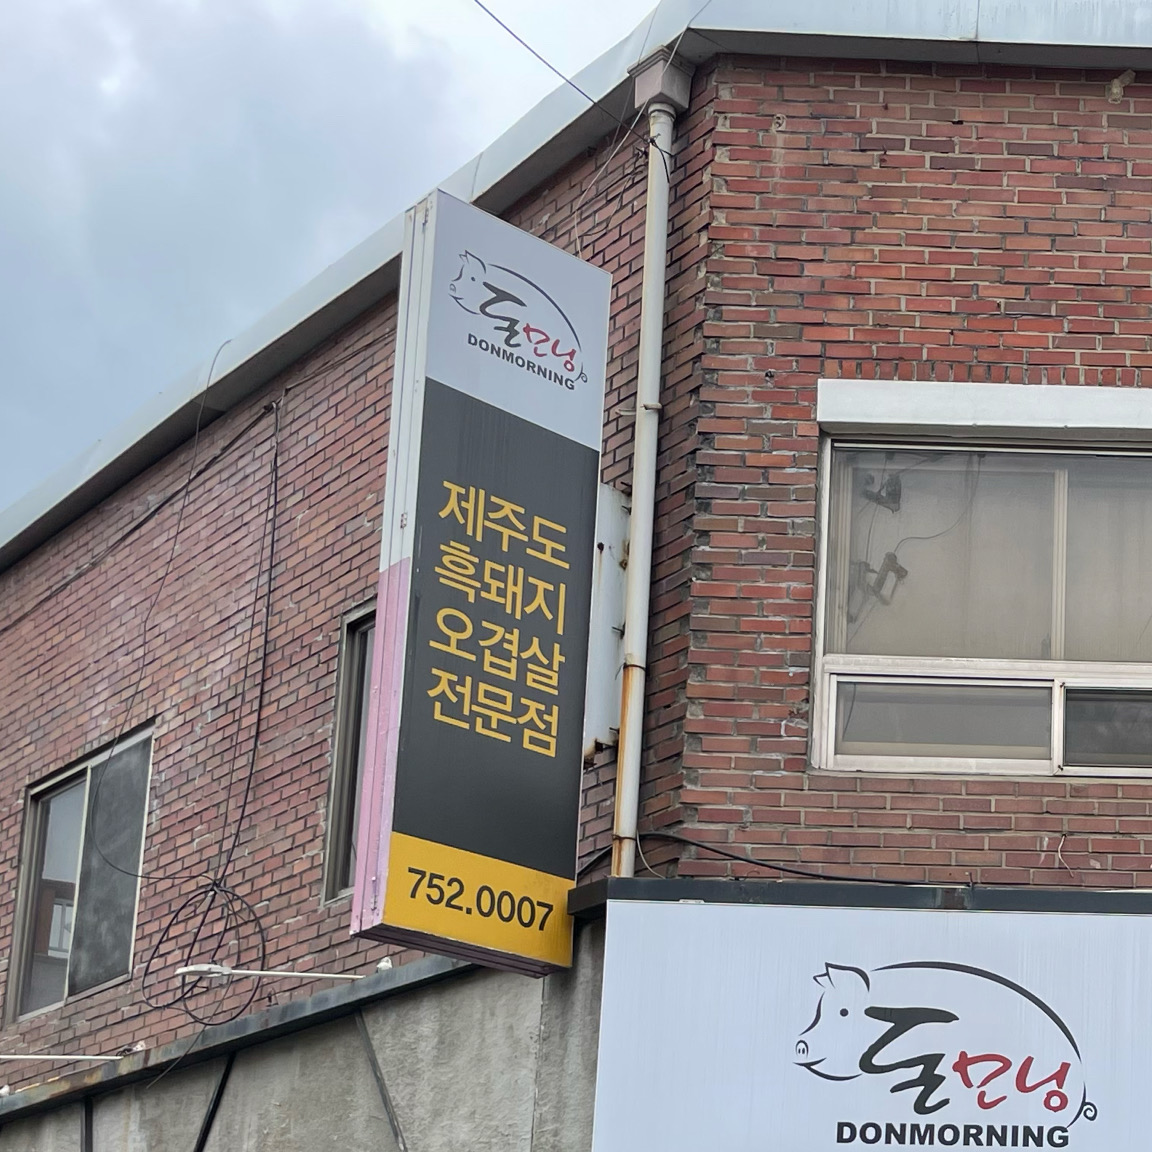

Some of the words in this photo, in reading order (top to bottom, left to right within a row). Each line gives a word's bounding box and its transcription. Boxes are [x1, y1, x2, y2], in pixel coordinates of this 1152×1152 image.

[467, 333, 575, 390] DONMORNING
[438, 480, 570, 569] 제주도
[434, 540, 566, 635] 흑돼지
[428, 607, 565, 696] 오겹살
[427, 667, 559, 758] 전문점
[407, 867, 554, 931] 752.0007
[836, 1121, 1069, 1148] DONMORNING
